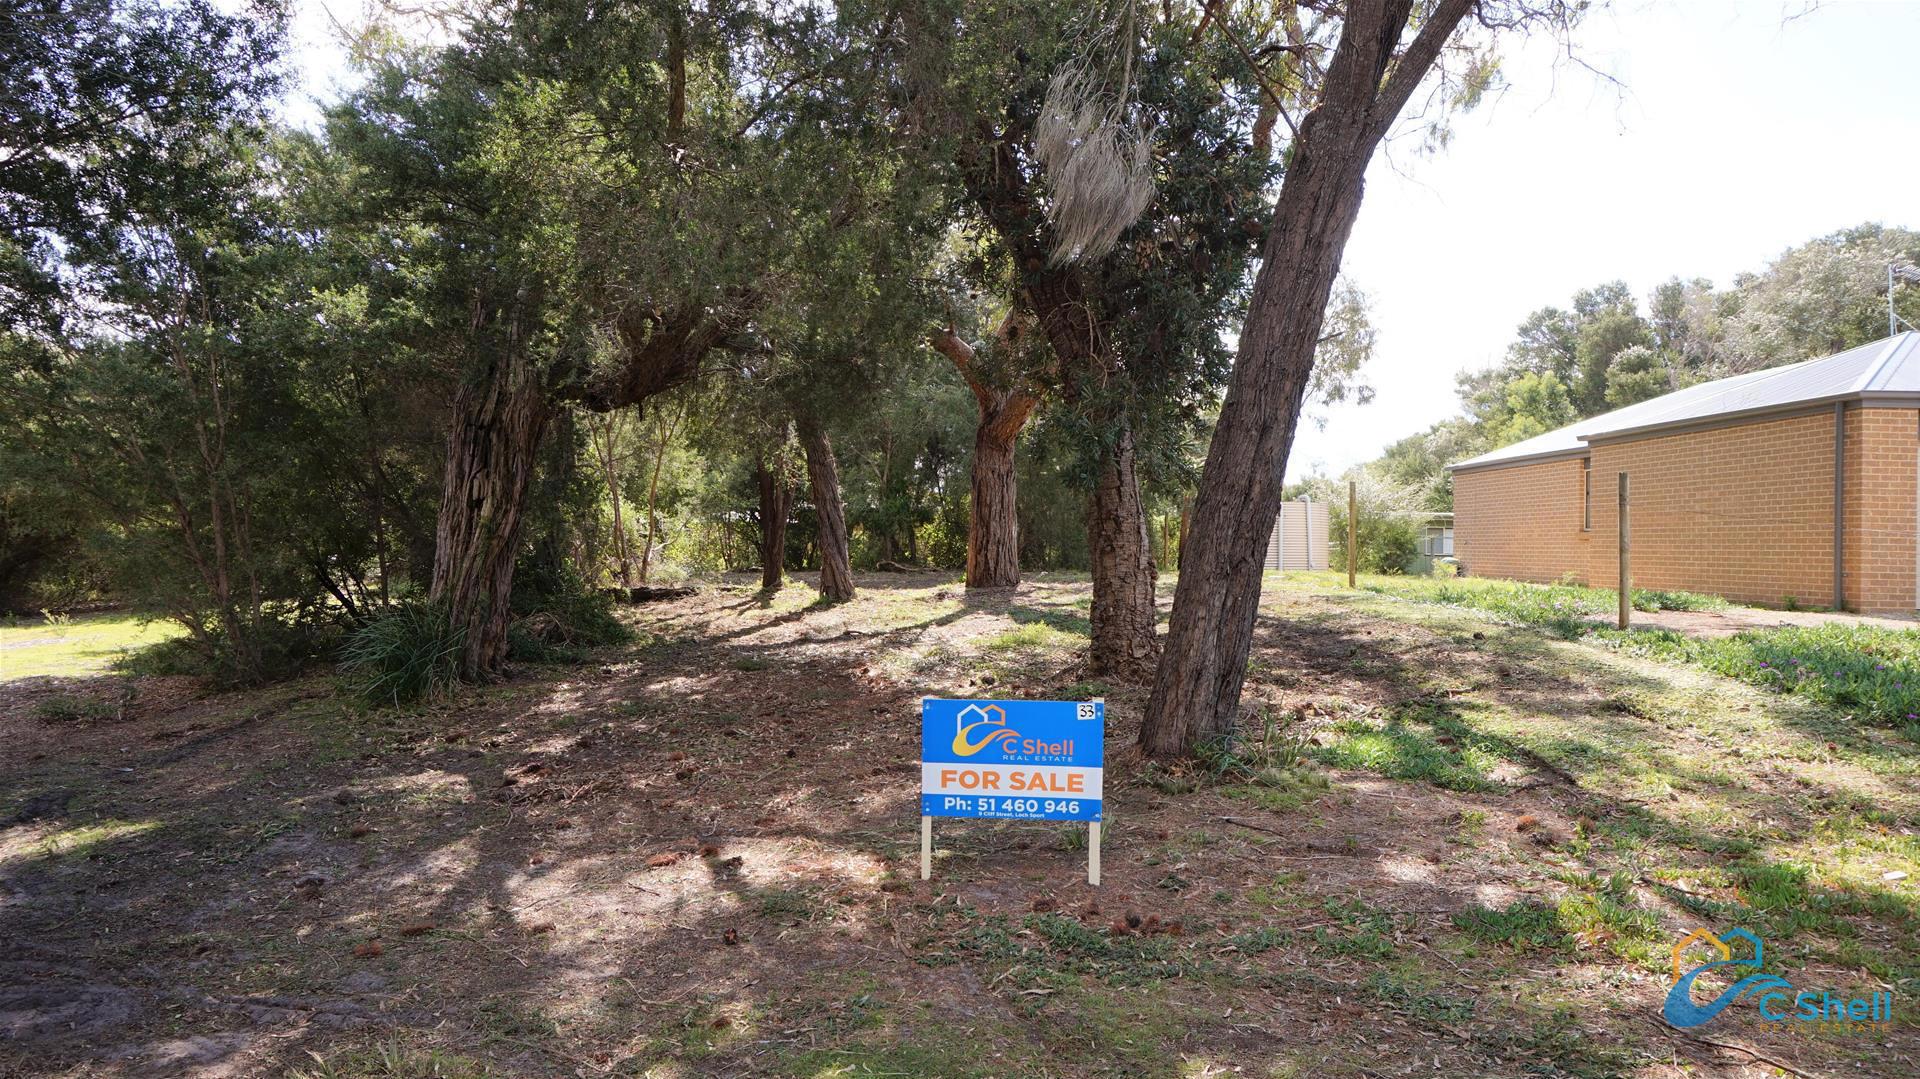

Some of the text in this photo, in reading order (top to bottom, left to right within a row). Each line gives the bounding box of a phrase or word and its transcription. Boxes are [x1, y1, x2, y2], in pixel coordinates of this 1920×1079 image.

[1079, 705, 1095, 718] 33
[1002, 739, 1074, 756] C Shell
[940, 769, 1085, 793] FOR SALE
[944, 797, 1080, 814] Ph: 51 460 946
